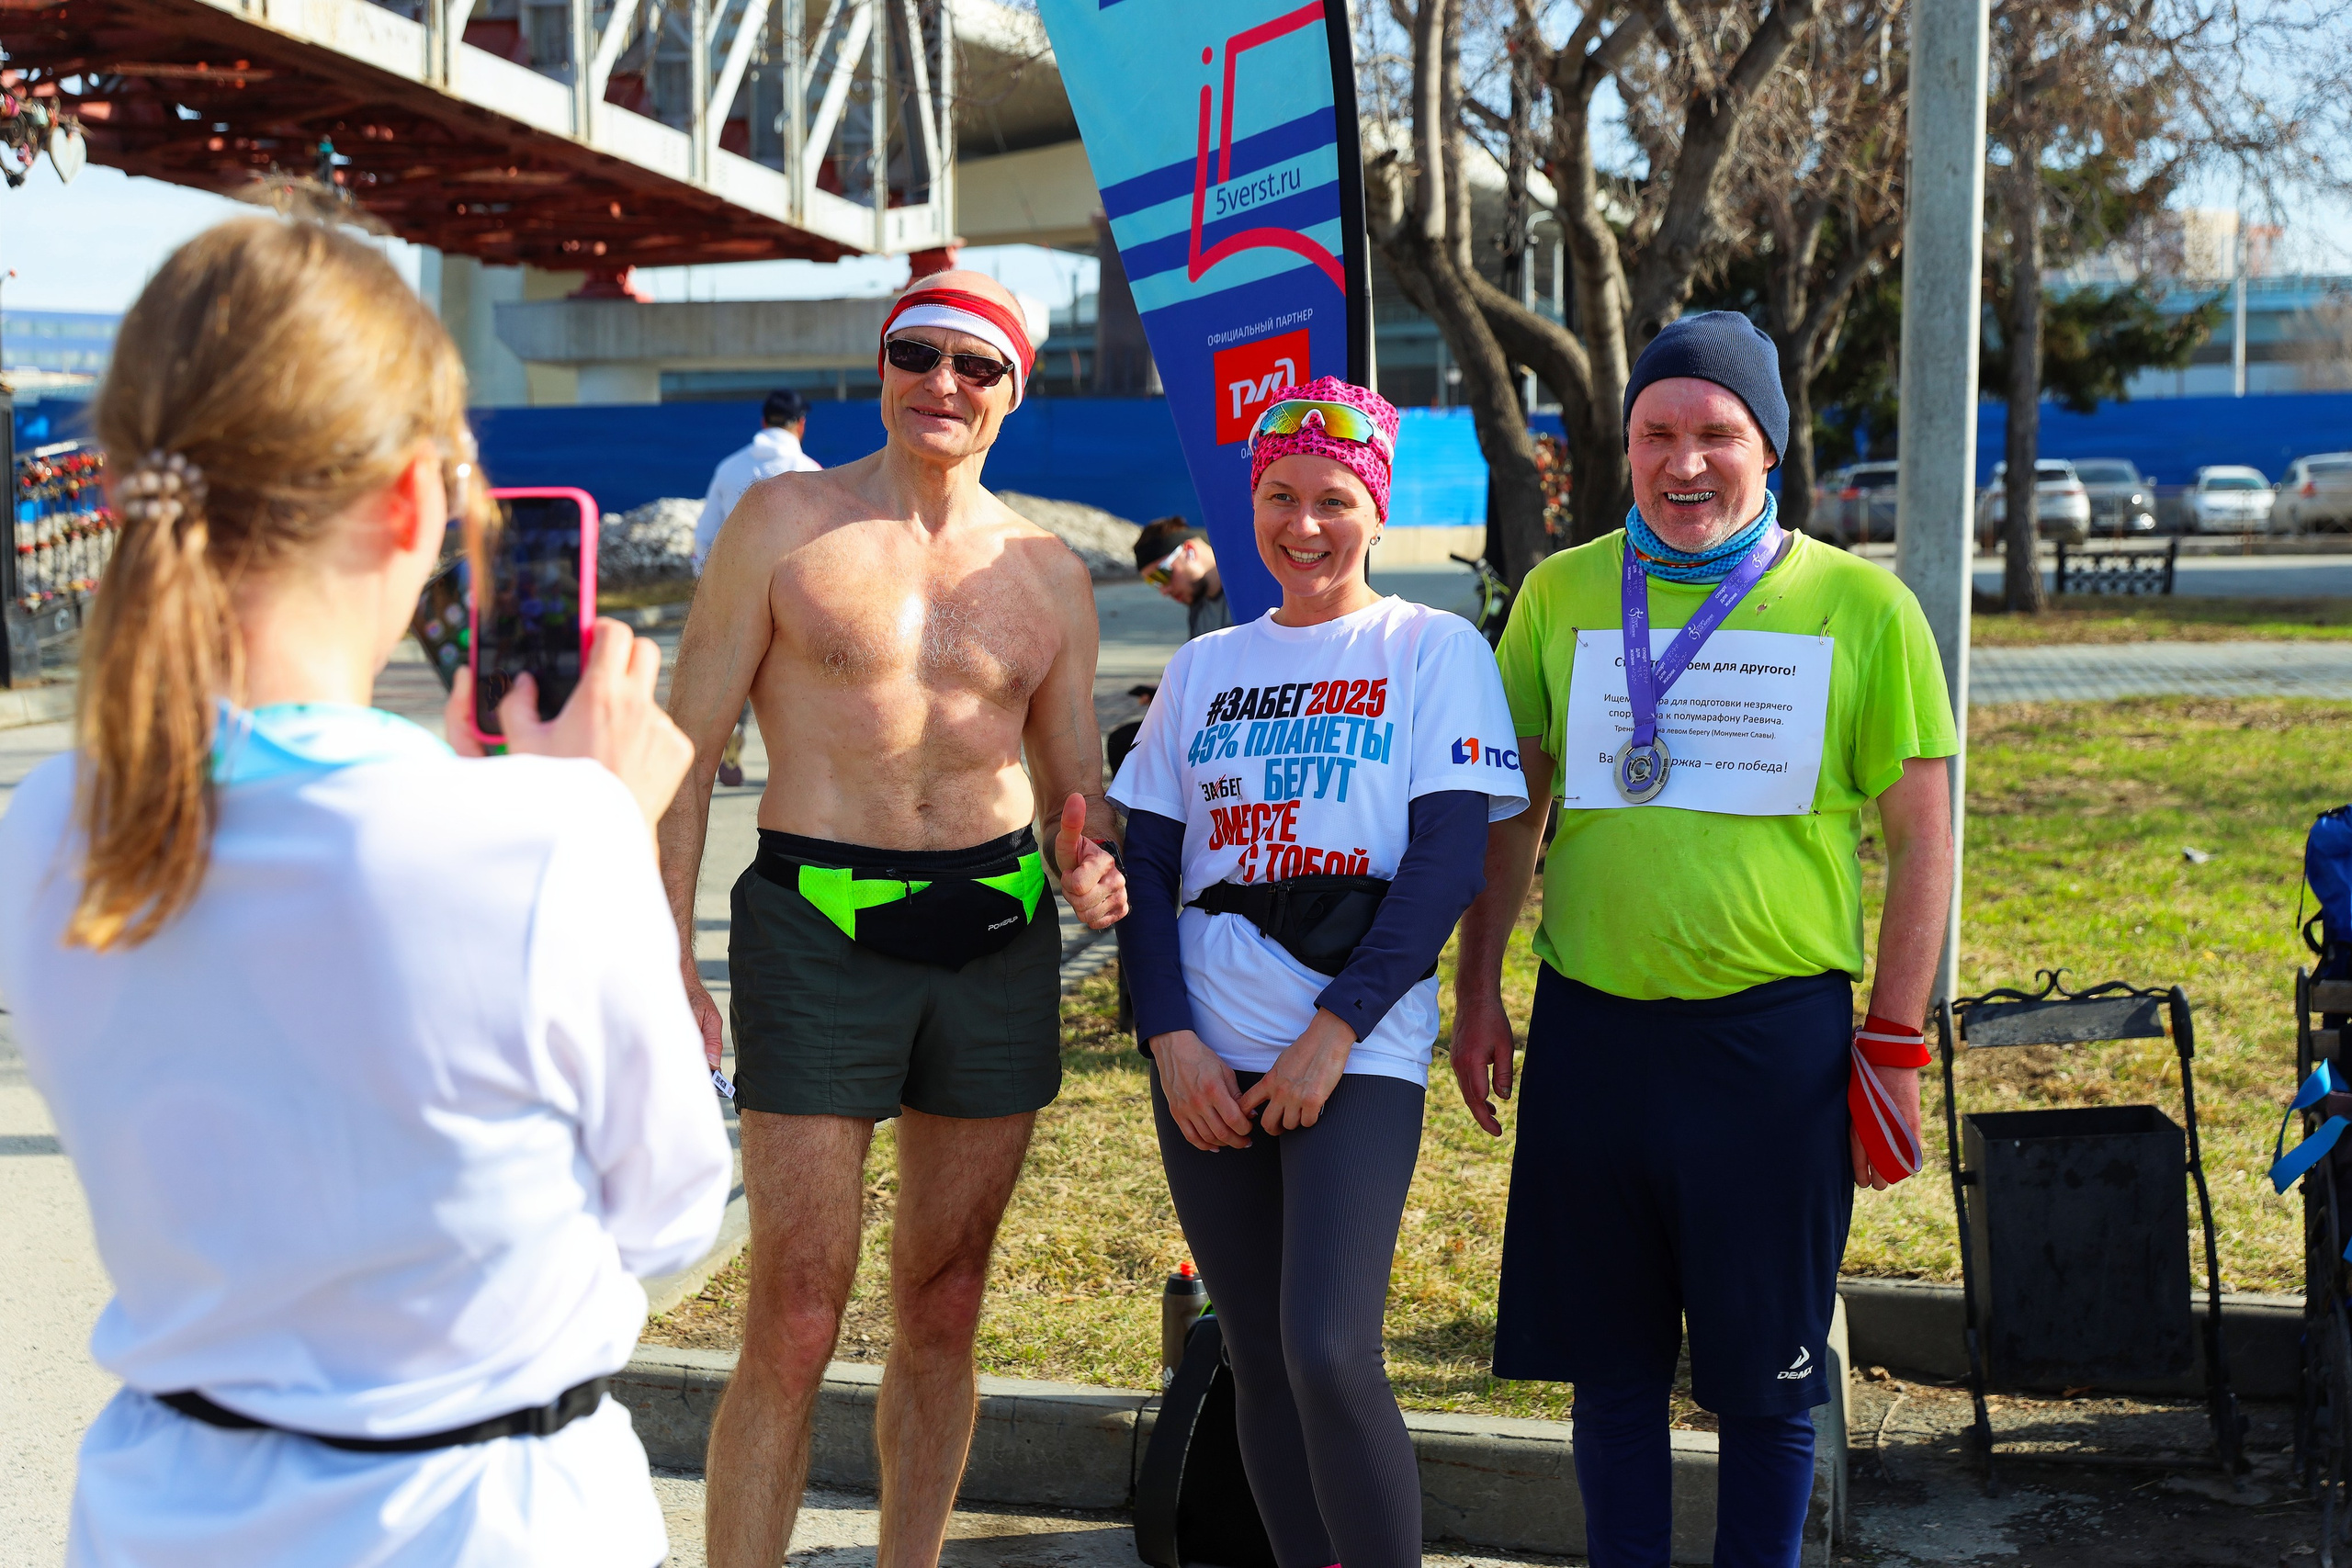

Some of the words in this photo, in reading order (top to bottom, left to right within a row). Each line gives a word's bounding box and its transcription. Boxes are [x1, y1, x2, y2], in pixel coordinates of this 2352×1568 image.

[1216, 165, 1301, 216] 5verst.ru
[1207, 317, 1274, 346] ОФИЦИАЛЬНЫЙ
[1275, 308, 1314, 329] ПАРТНЕР
[1240, 446, 1257, 459] ОА
[1713, 662, 1736, 673] для
[1739, 663, 1796, 676] другого!
[1205, 677, 1388, 727] #ЗАБЕГ2025
[1690, 699, 1741, 707] подготовки
[1744, 701, 1792, 712] незрячего
[1674, 713, 1741, 724] полумарафону
[1743, 715, 1784, 725] Раевича.
[1187, 722, 1243, 769] 45%
[1244, 716, 1394, 764] ПЛАНЕТЫ
[1689, 728, 1710, 737] берегу
[1711, 729, 1748, 738] (Монумент
[1750, 731, 1776, 739] Славы).
[1485, 746, 1522, 771] ПС
[1715, 761, 1735, 770] его
[1737, 760, 1788, 773] победа!
[1202, 777, 1242, 802] ЗАБЕГ
[1263, 756, 1357, 803] БЕГУТ
[1208, 800, 1301, 851] ВМЕСТЕ
[1238, 843, 1259, 883] С
[1266, 843, 1370, 883] ТОБОЙ
[988, 915, 1018, 931] POWERUP
